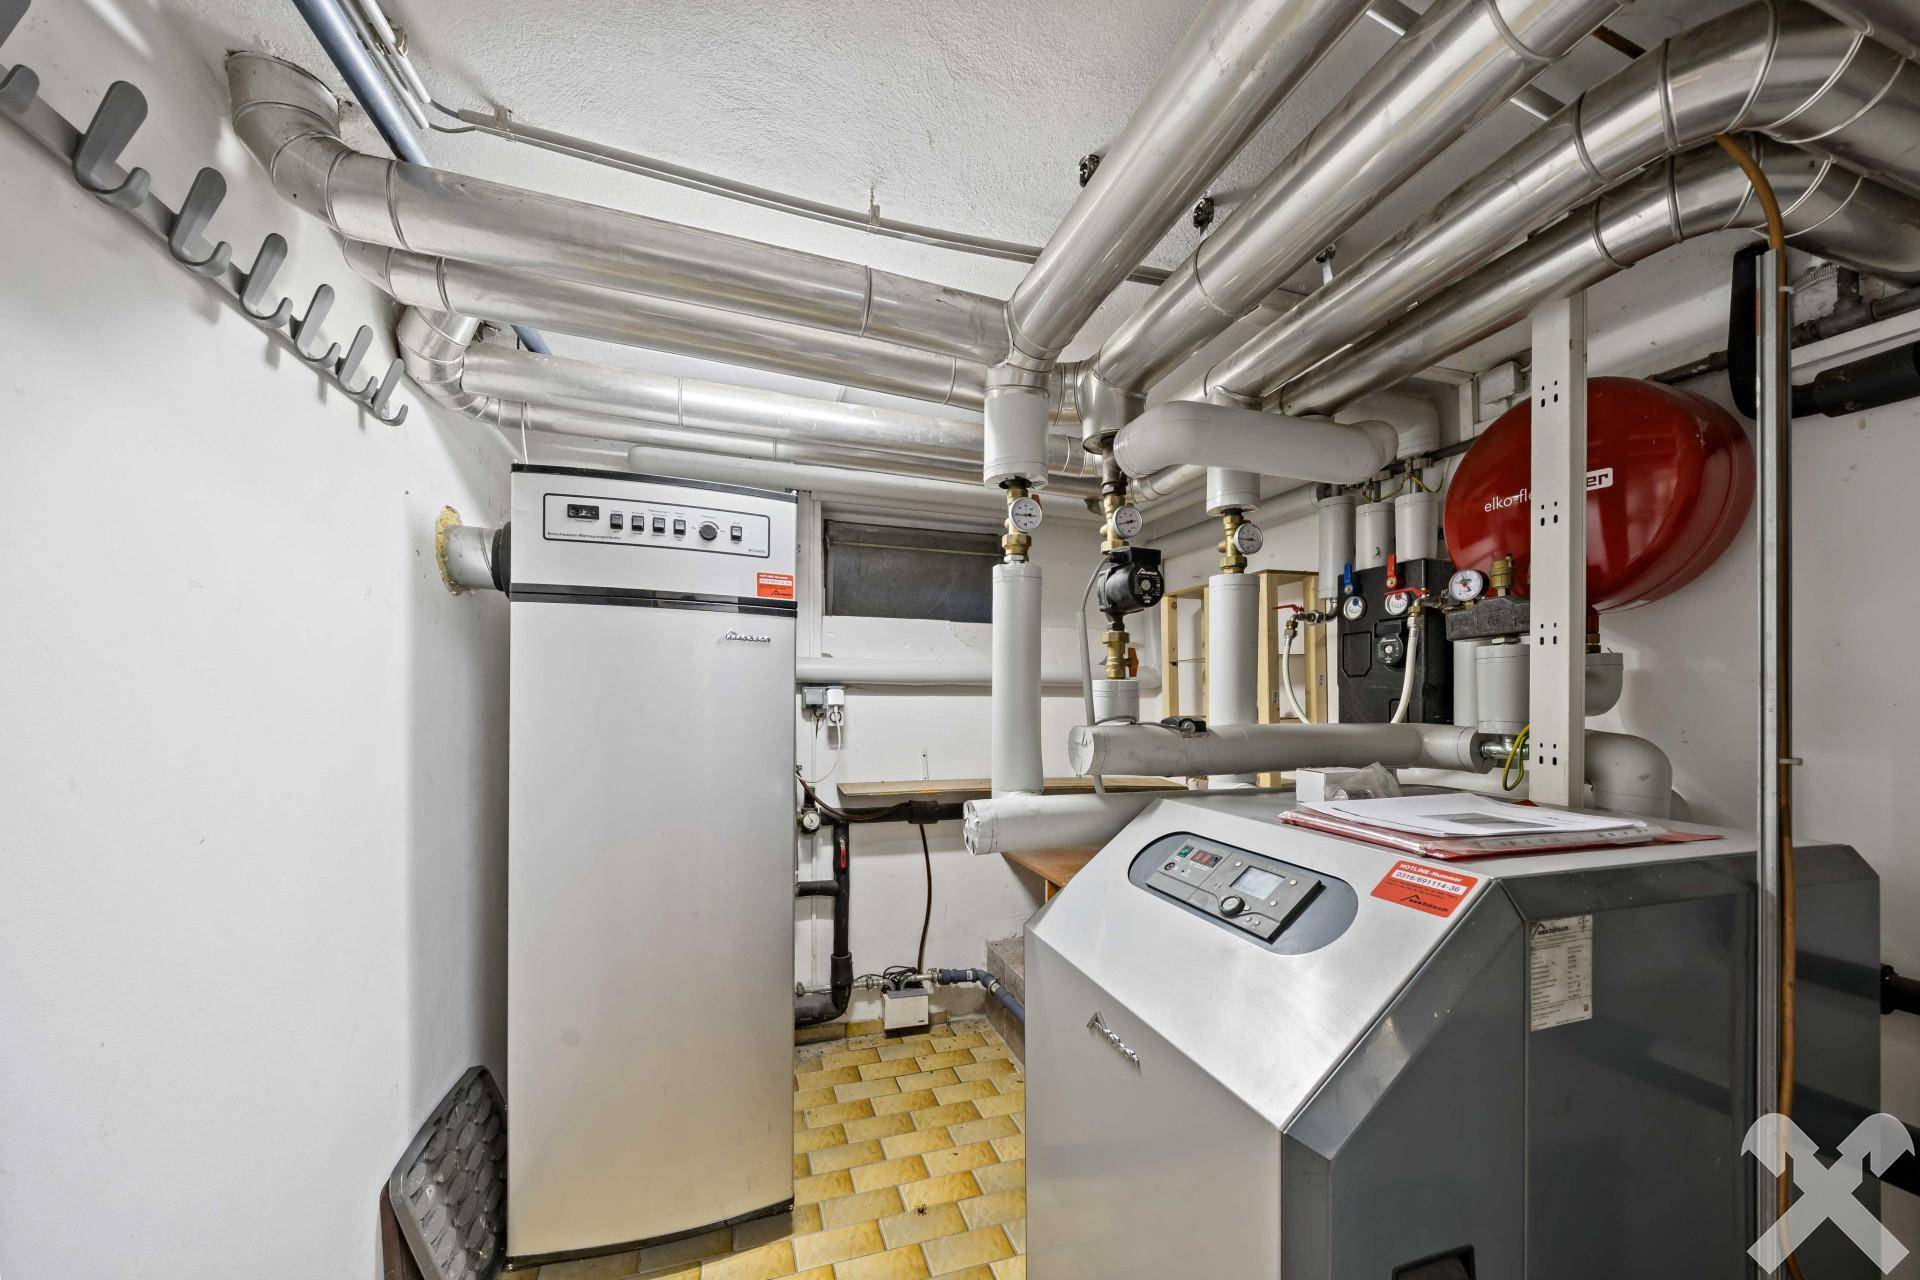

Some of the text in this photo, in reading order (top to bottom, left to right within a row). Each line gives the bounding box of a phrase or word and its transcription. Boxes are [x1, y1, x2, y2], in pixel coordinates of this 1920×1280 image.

[1586, 473, 1609, 487] er
[1395, 871, 1462, 892] 0316/691114-36
[1399, 863, 1464, 882] HOTLINE-Nummer
